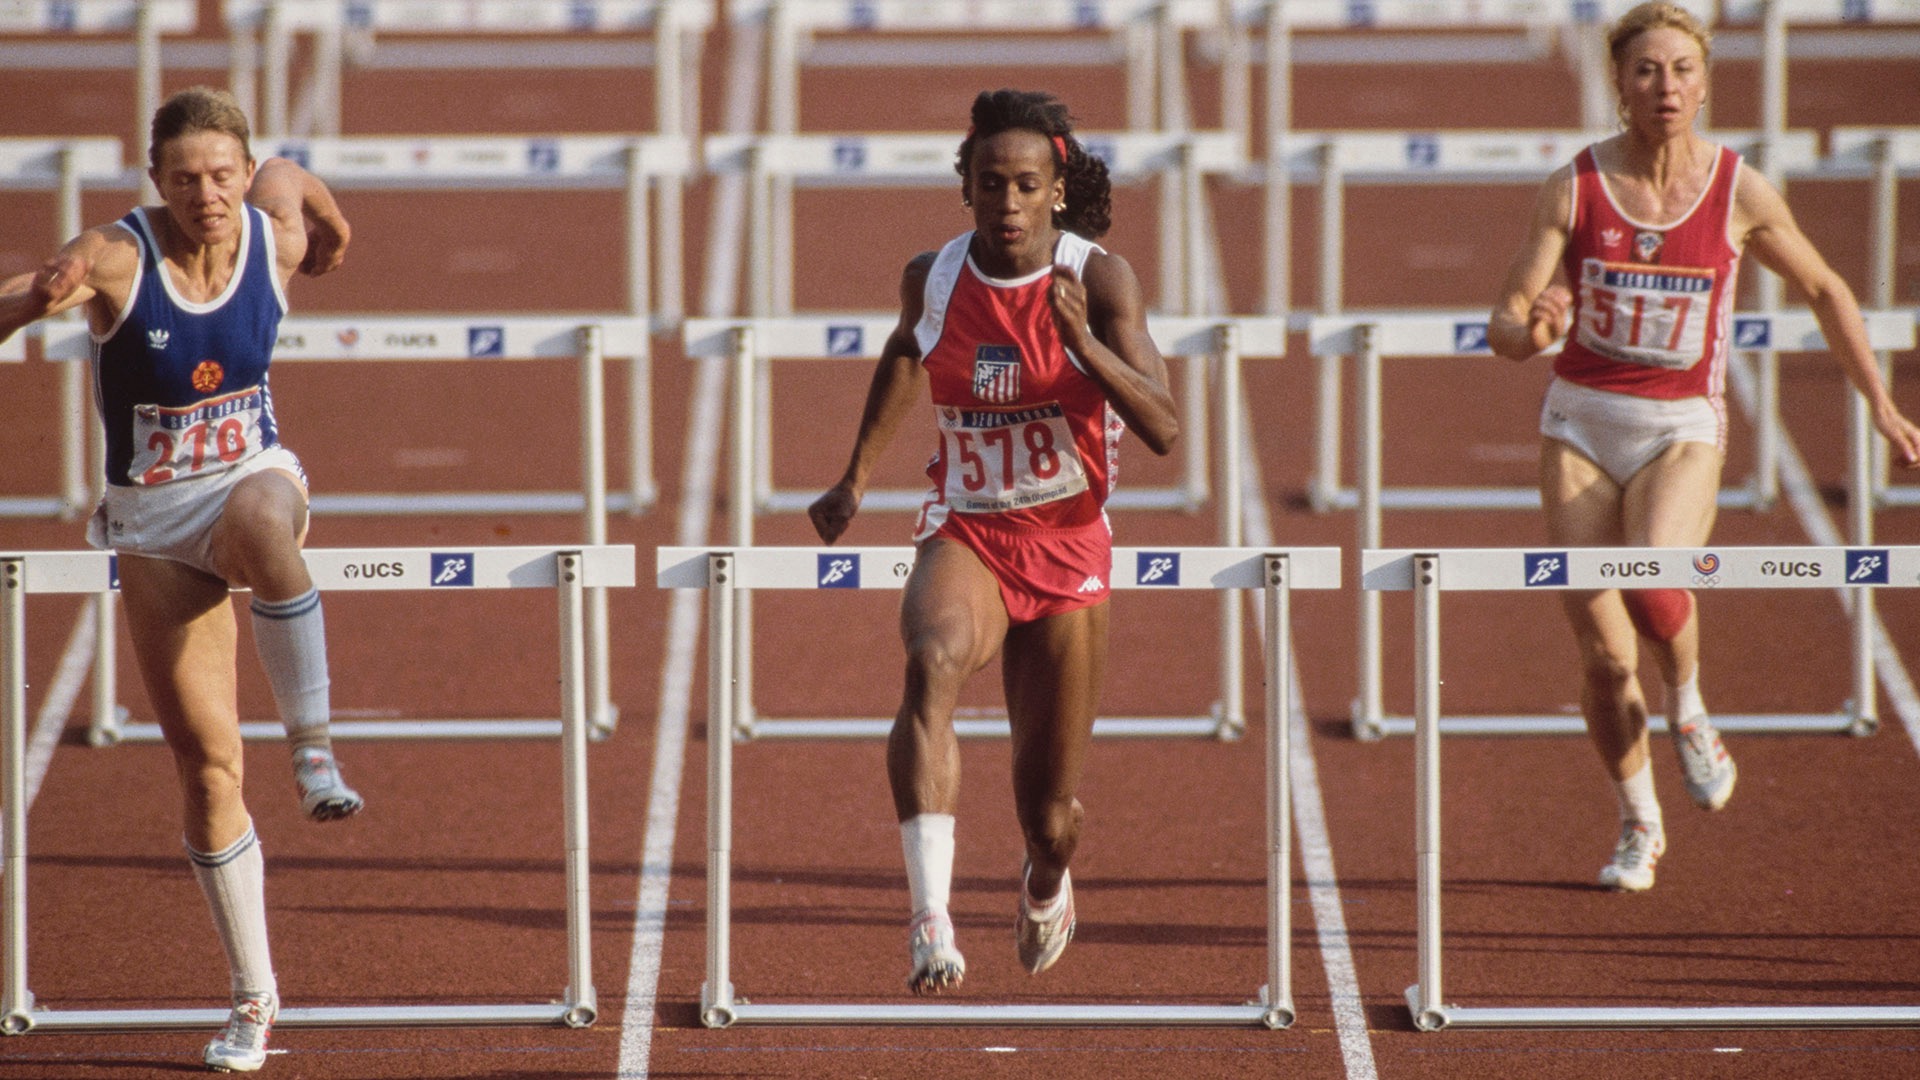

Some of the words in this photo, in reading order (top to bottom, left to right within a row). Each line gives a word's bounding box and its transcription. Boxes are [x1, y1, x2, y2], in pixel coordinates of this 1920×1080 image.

[1591, 287, 1693, 352] 517
[170, 407, 214, 429] SEOUL
[971, 411, 1012, 427] SEOUL
[953, 421, 1061, 492] 578
[362, 562, 404, 578] UCS
[1618, 561, 1661, 577] UCS
[1779, 561, 1822, 577] UCS
